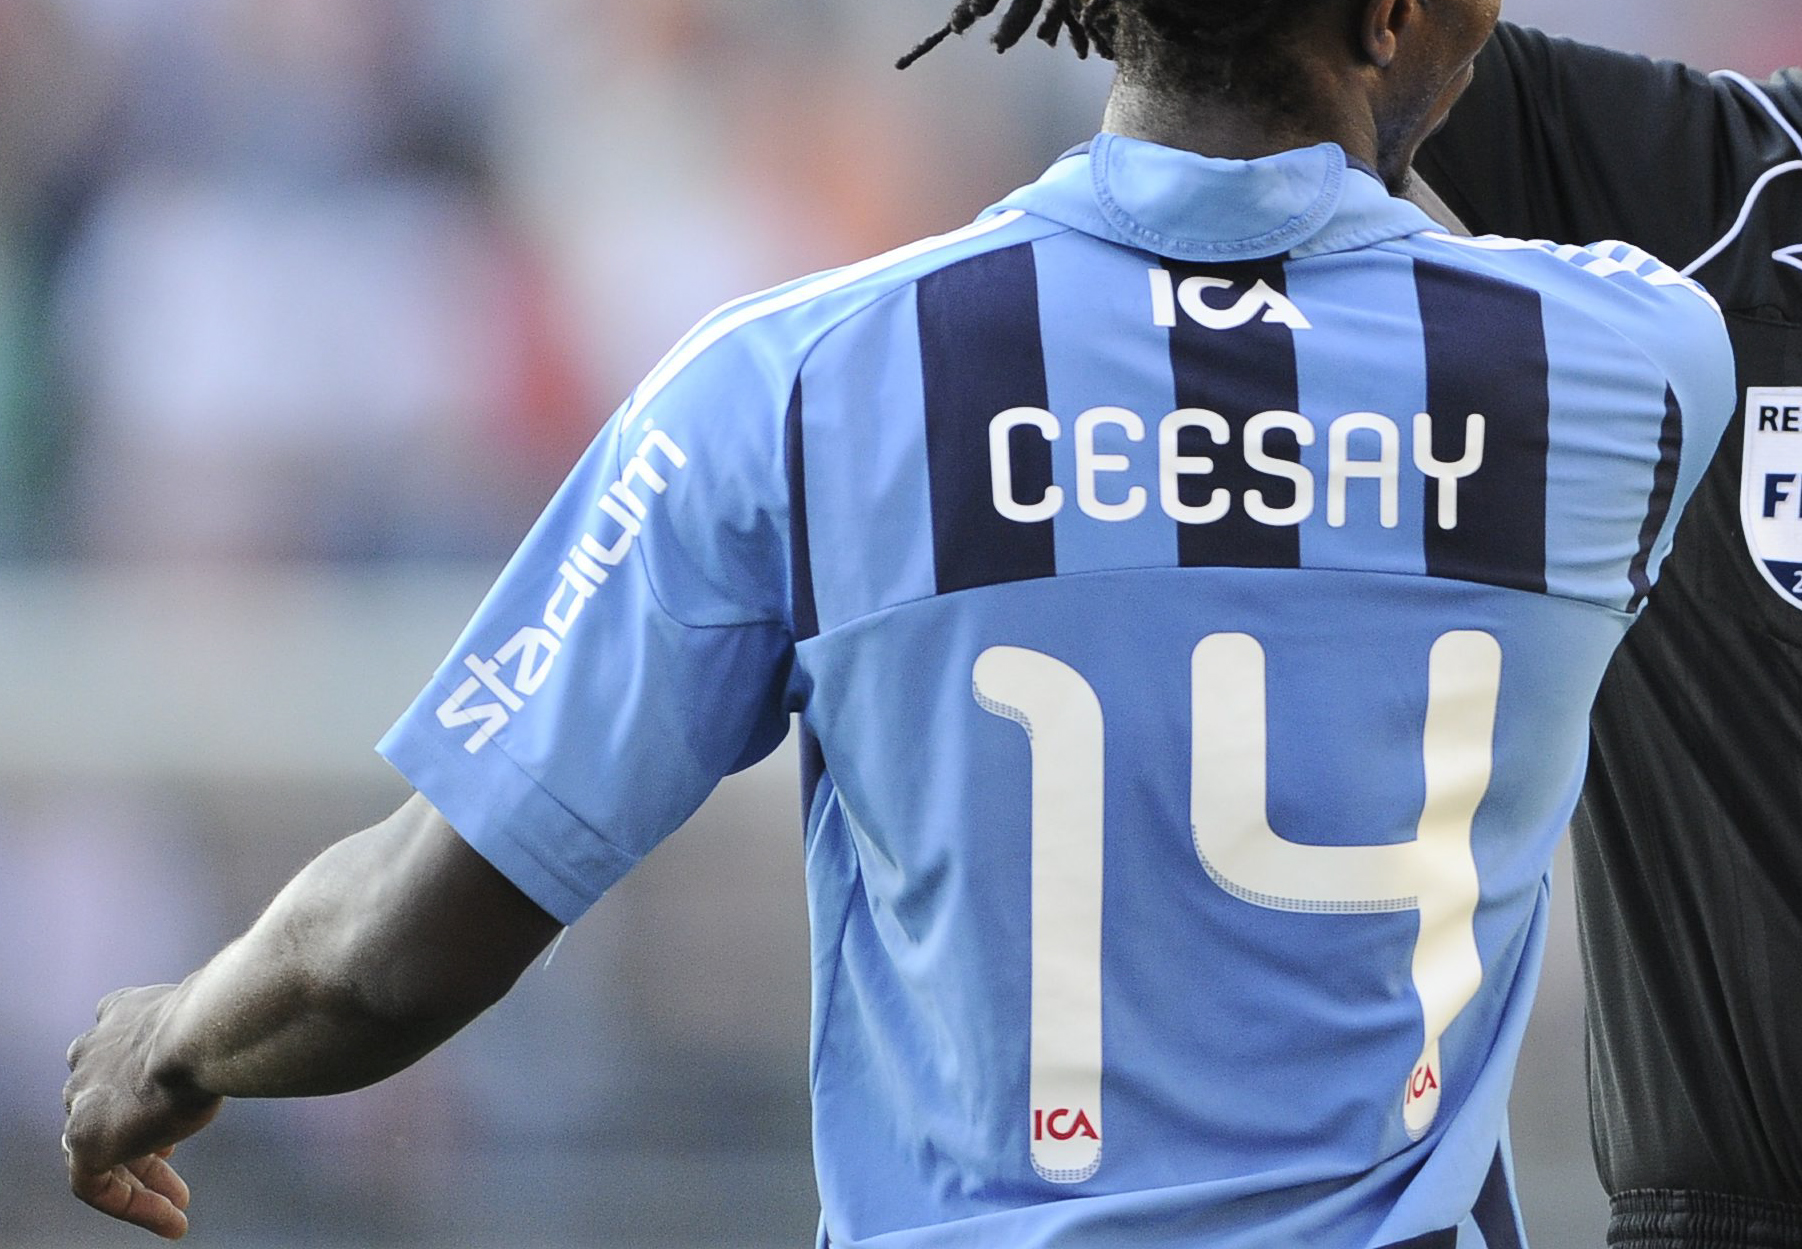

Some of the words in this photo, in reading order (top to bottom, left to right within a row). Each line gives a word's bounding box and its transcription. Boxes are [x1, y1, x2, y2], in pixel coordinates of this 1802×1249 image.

[1149, 267, 1313, 330] ICA
[988, 405, 1487, 531] CEESAY
[435, 428, 689, 754] stadium
[971, 629, 1504, 1185] 14
[1032, 1107, 1101, 1142] ICA
[1405, 1061, 1438, 1105] ICA
